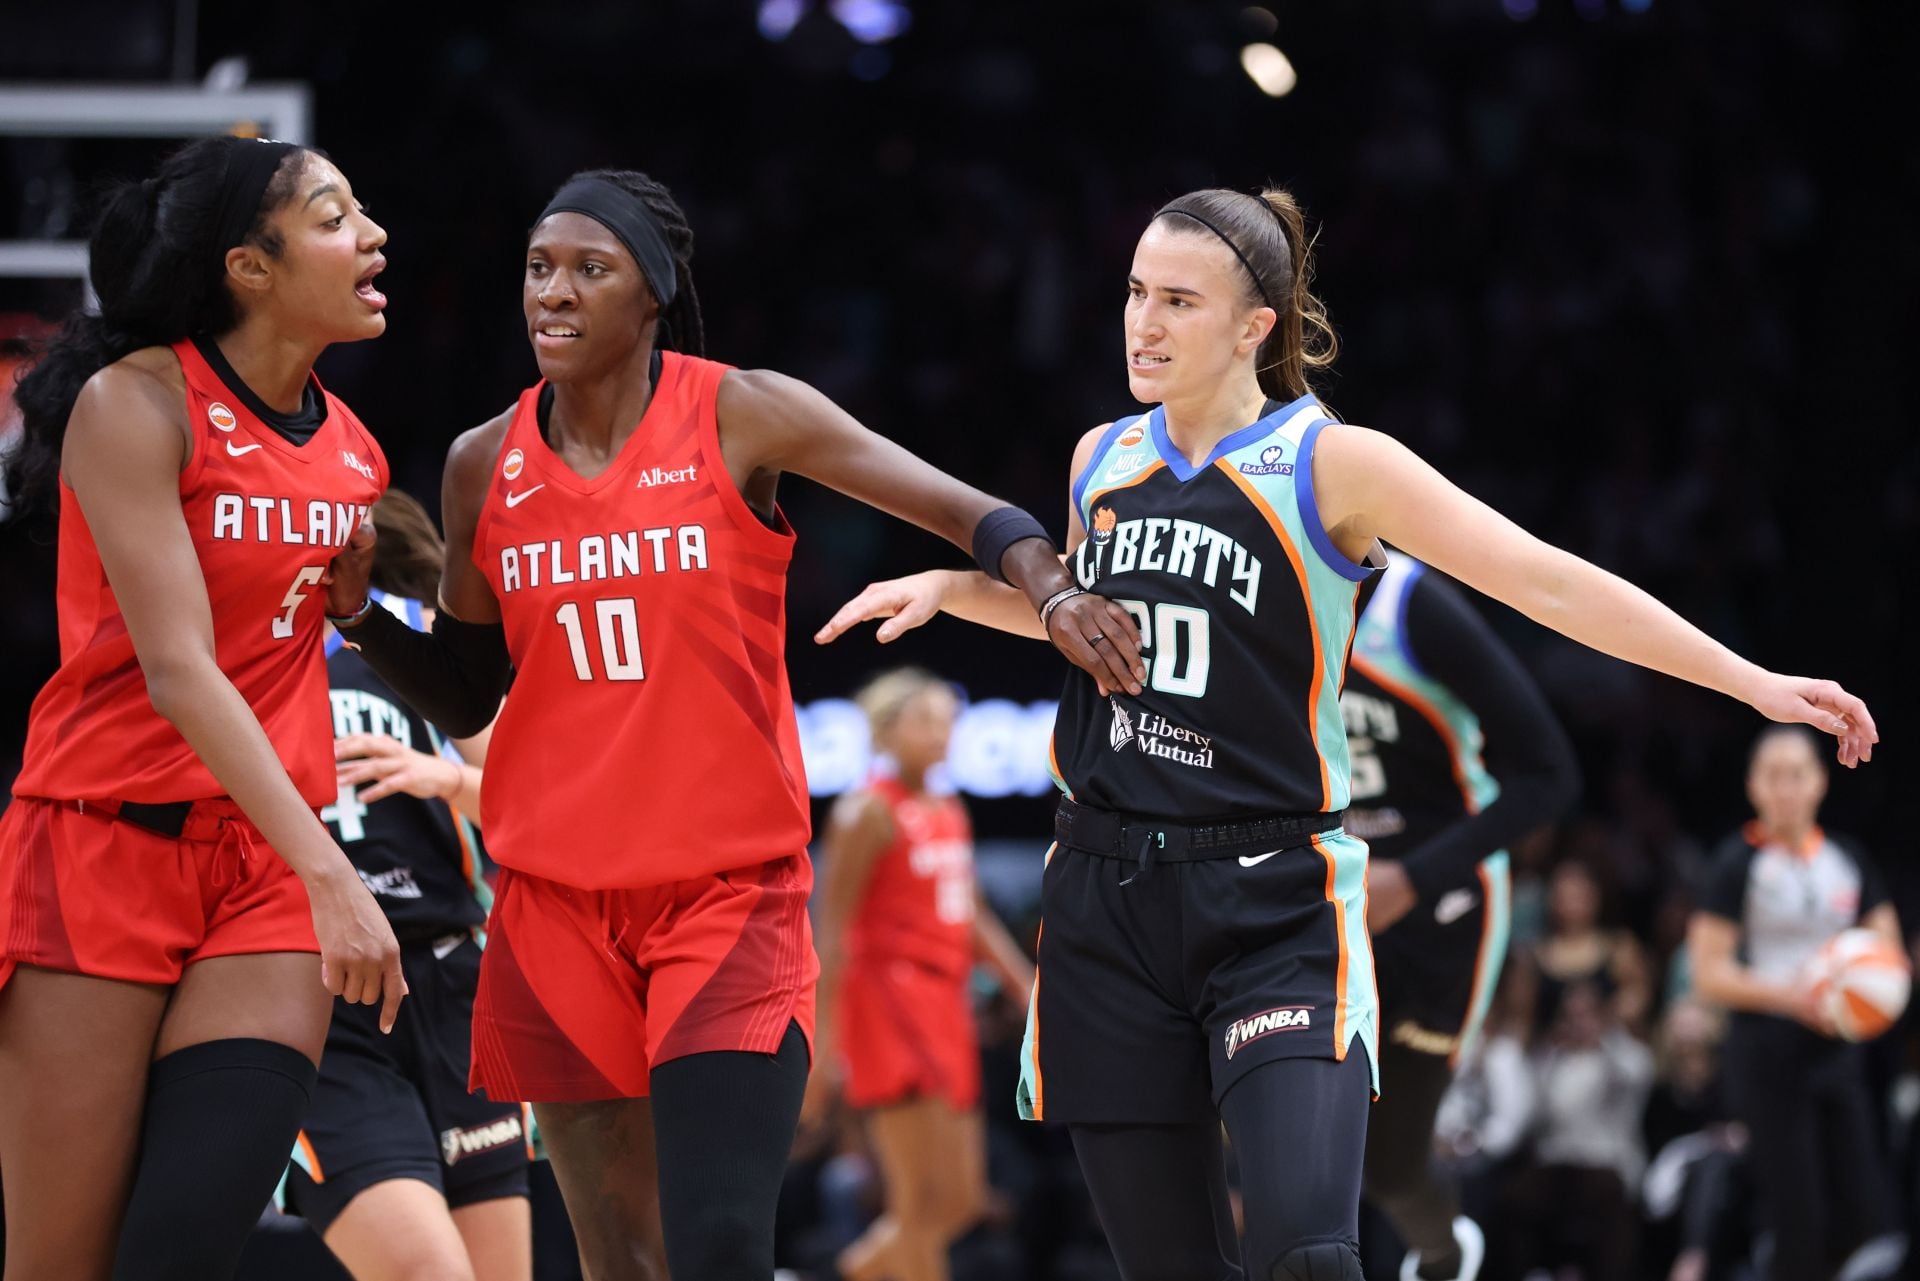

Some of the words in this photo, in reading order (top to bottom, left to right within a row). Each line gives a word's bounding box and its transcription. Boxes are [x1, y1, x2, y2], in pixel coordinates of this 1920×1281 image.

[637, 465, 697, 488] Albert
[1112, 453, 1146, 472] NIKE
[1242, 464, 1292, 475] BARCLAYS
[501, 522, 708, 593] ATLANTA
[271, 565, 325, 640] 5
[555, 597, 645, 682] 10
[1137, 711, 1211, 752] Liberty
[1137, 734, 1213, 769] Mutual
[1240, 1009, 1310, 1042] WNBA
